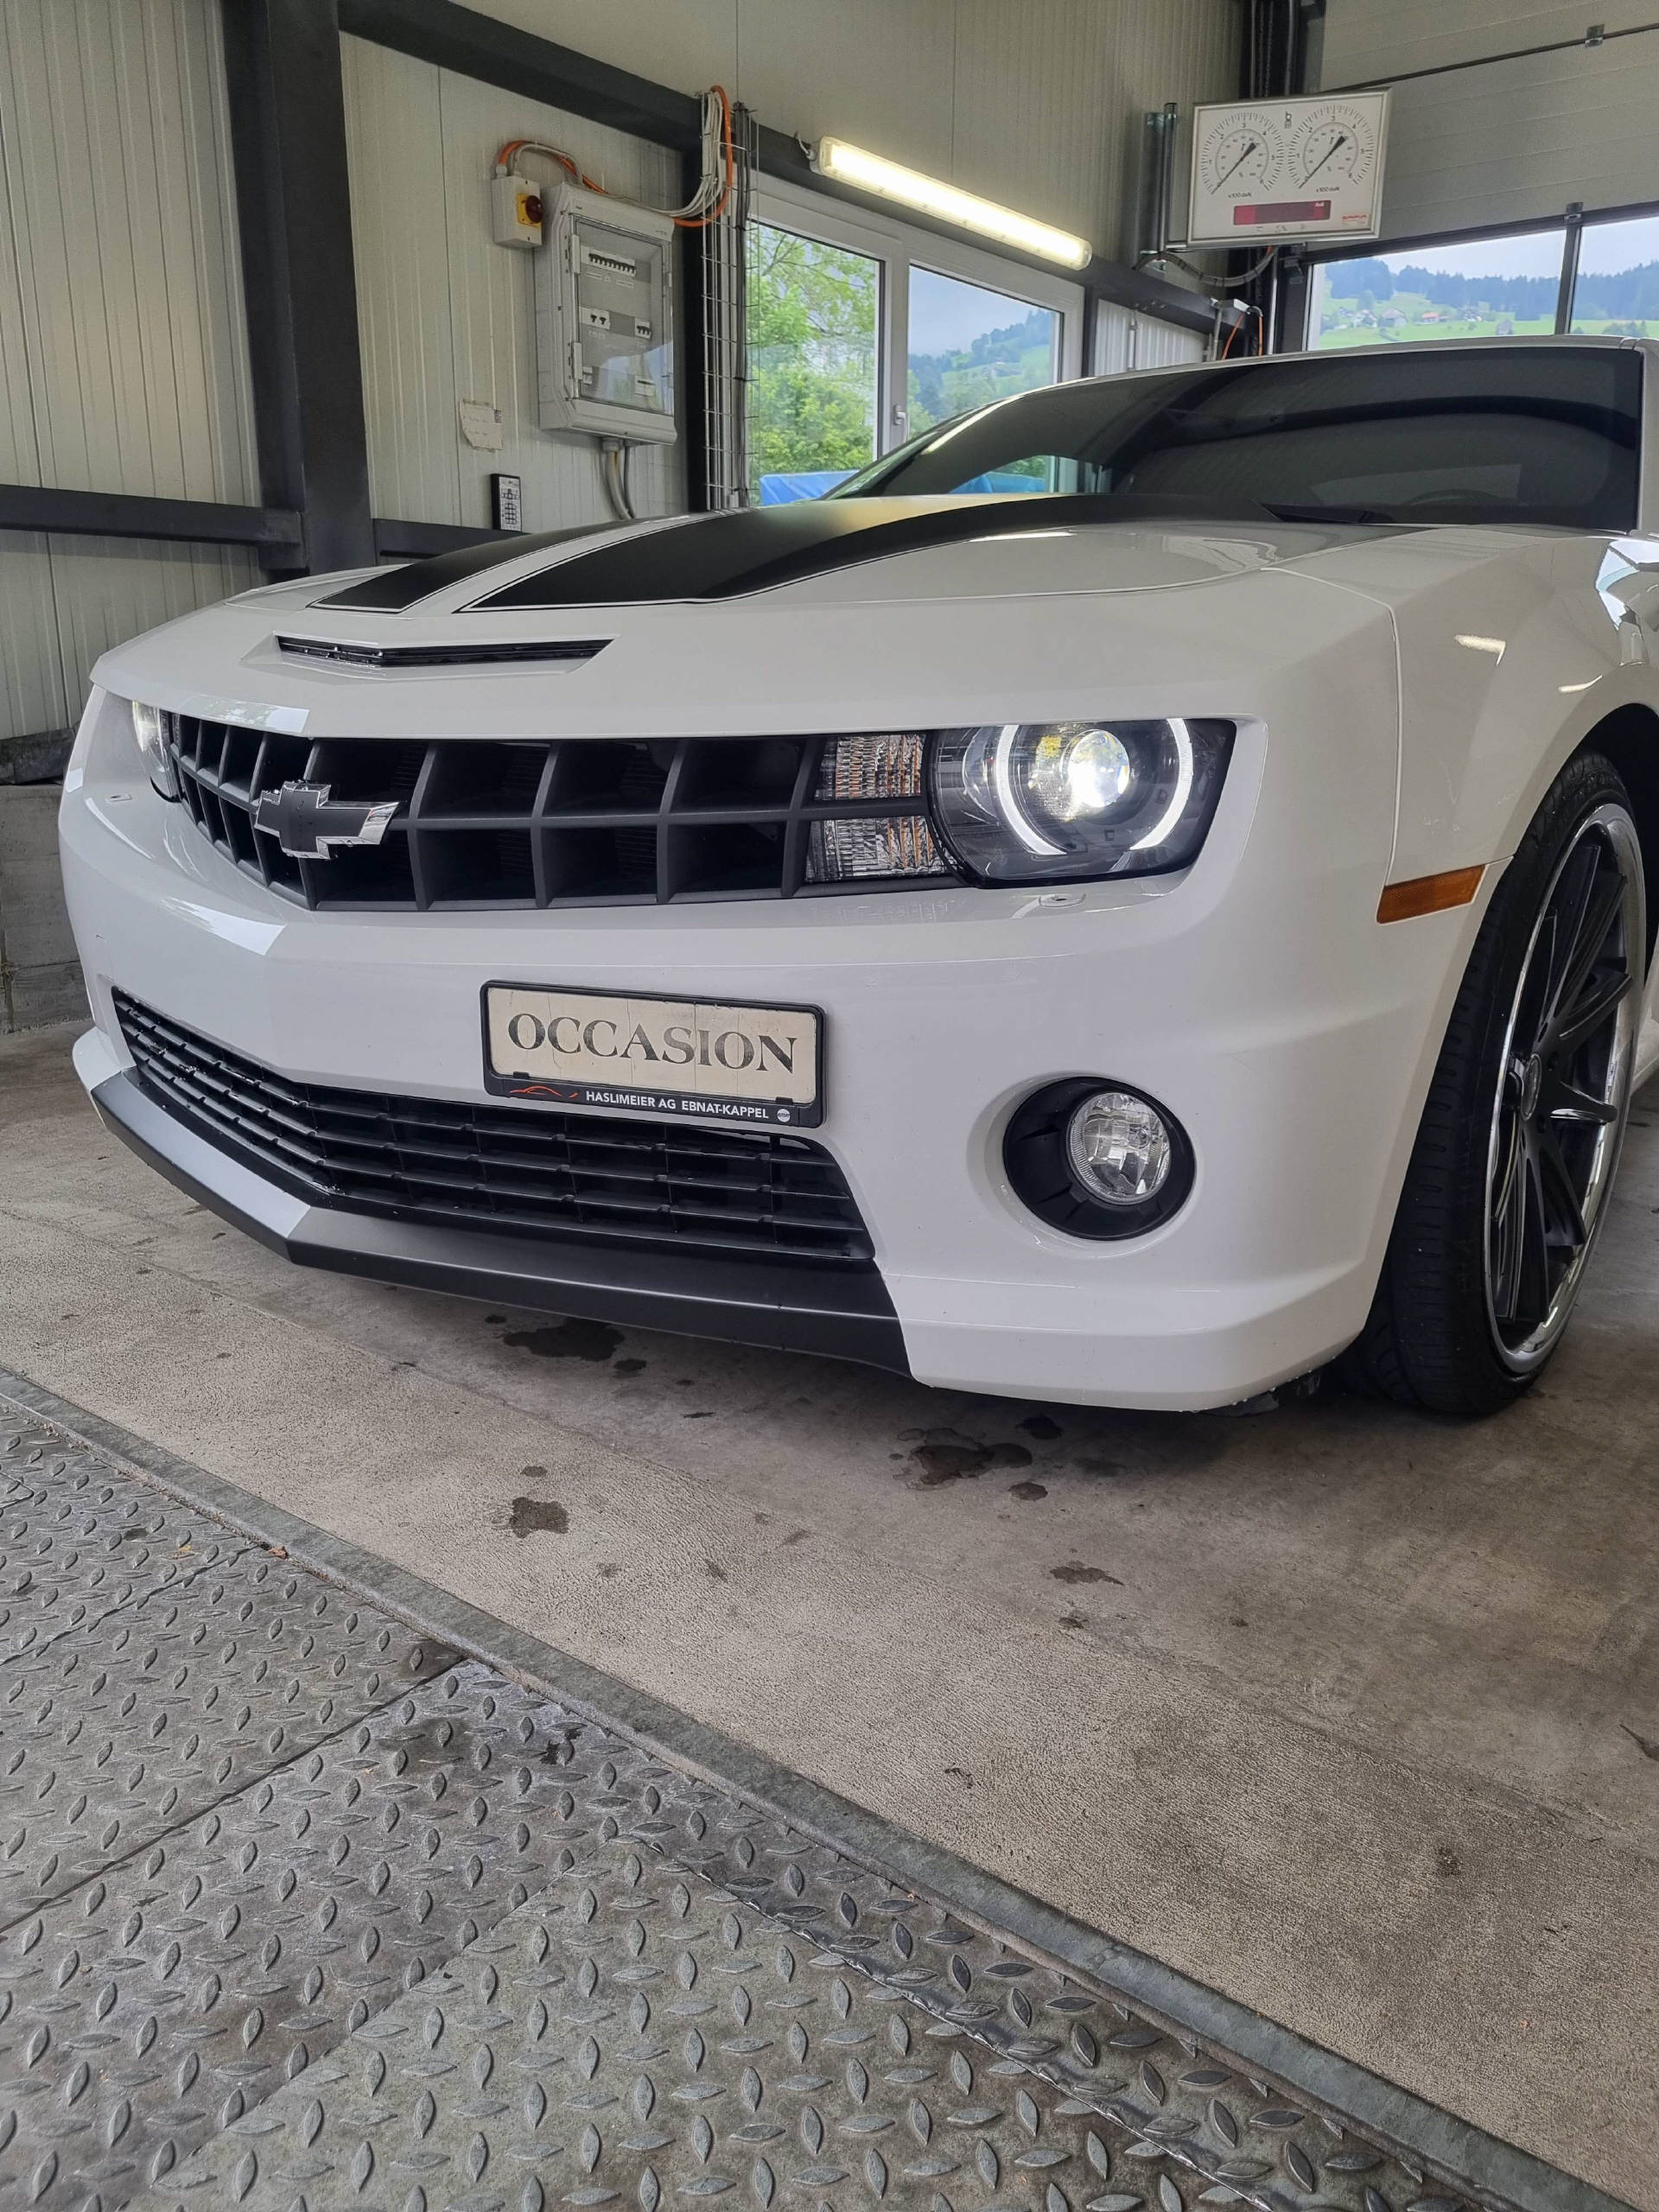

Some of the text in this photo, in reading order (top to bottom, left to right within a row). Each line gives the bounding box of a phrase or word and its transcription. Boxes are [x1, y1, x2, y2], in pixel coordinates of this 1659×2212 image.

[508, 1013, 798, 1074] OCCASION
[586, 1090, 769, 1119] HASLIMEIER AG EBNAT-KAPPEL
